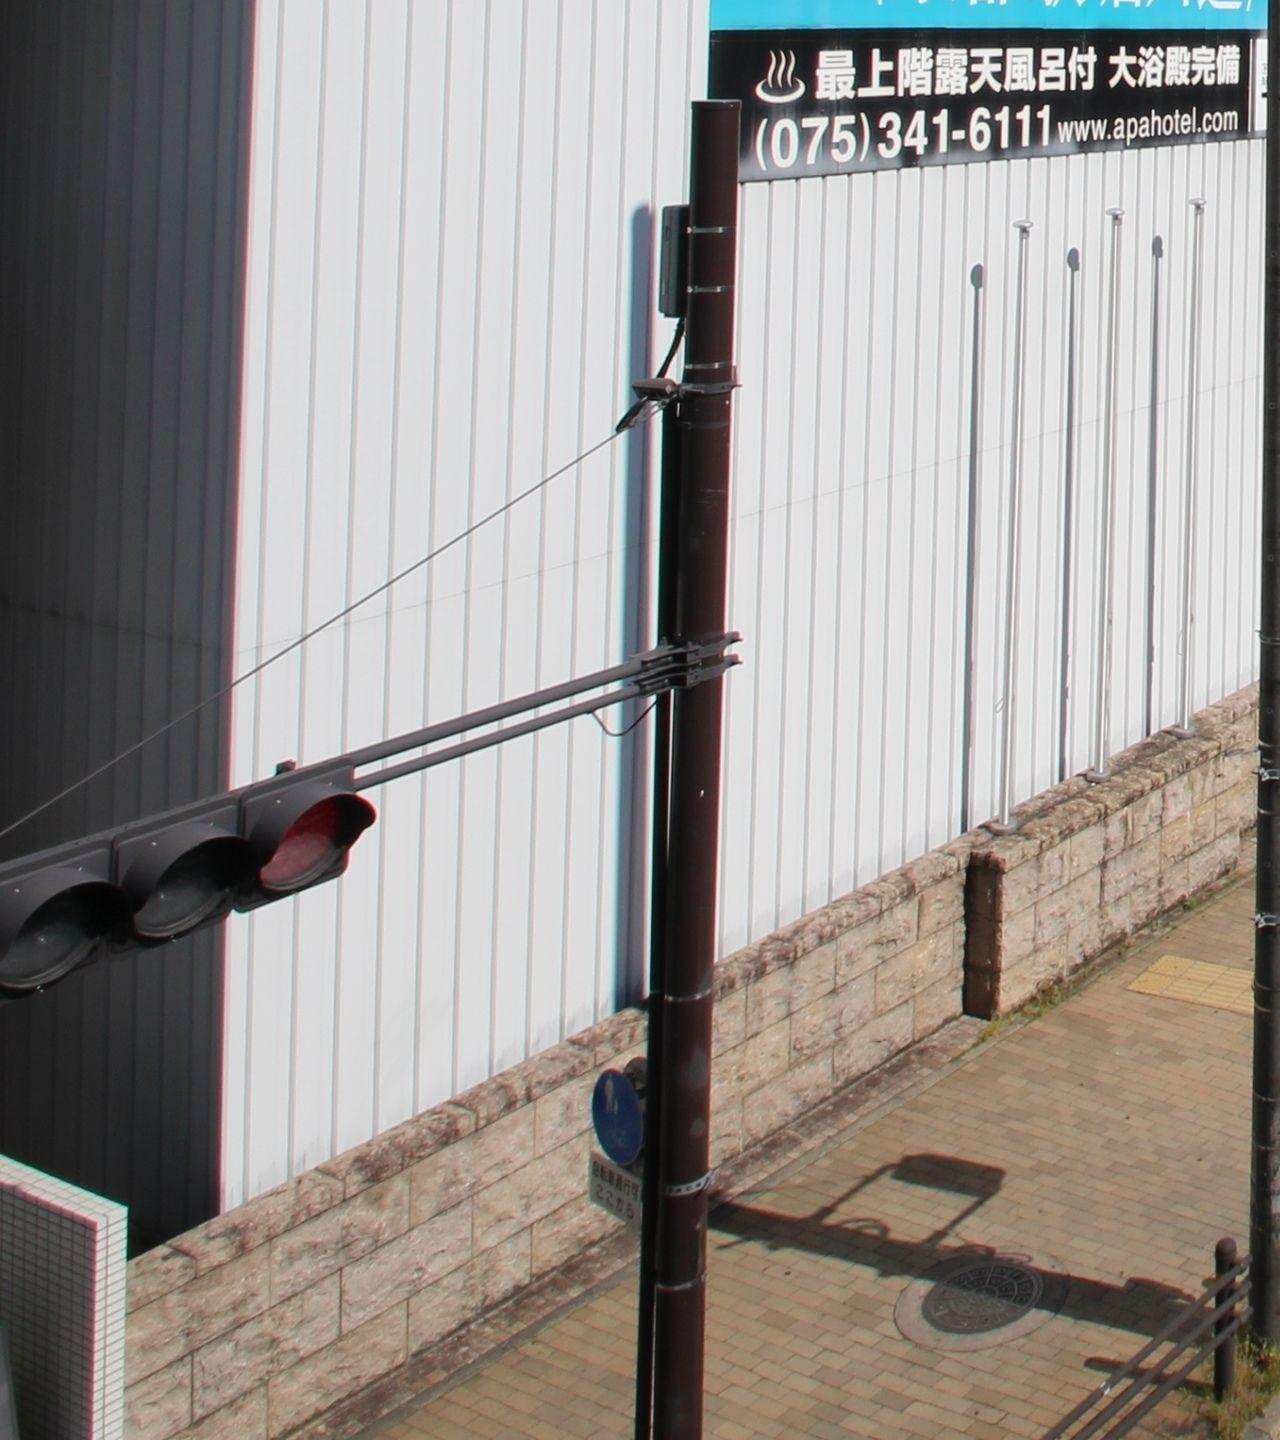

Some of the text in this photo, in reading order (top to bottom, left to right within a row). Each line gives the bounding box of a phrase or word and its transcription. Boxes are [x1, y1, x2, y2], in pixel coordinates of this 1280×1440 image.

[815, 46, 1098, 101] 最上階露天風呂付
[1108, 44, 1241, 89] 大浴殿完備
[1057, 106, 1239, 147] www.apahotel.com
